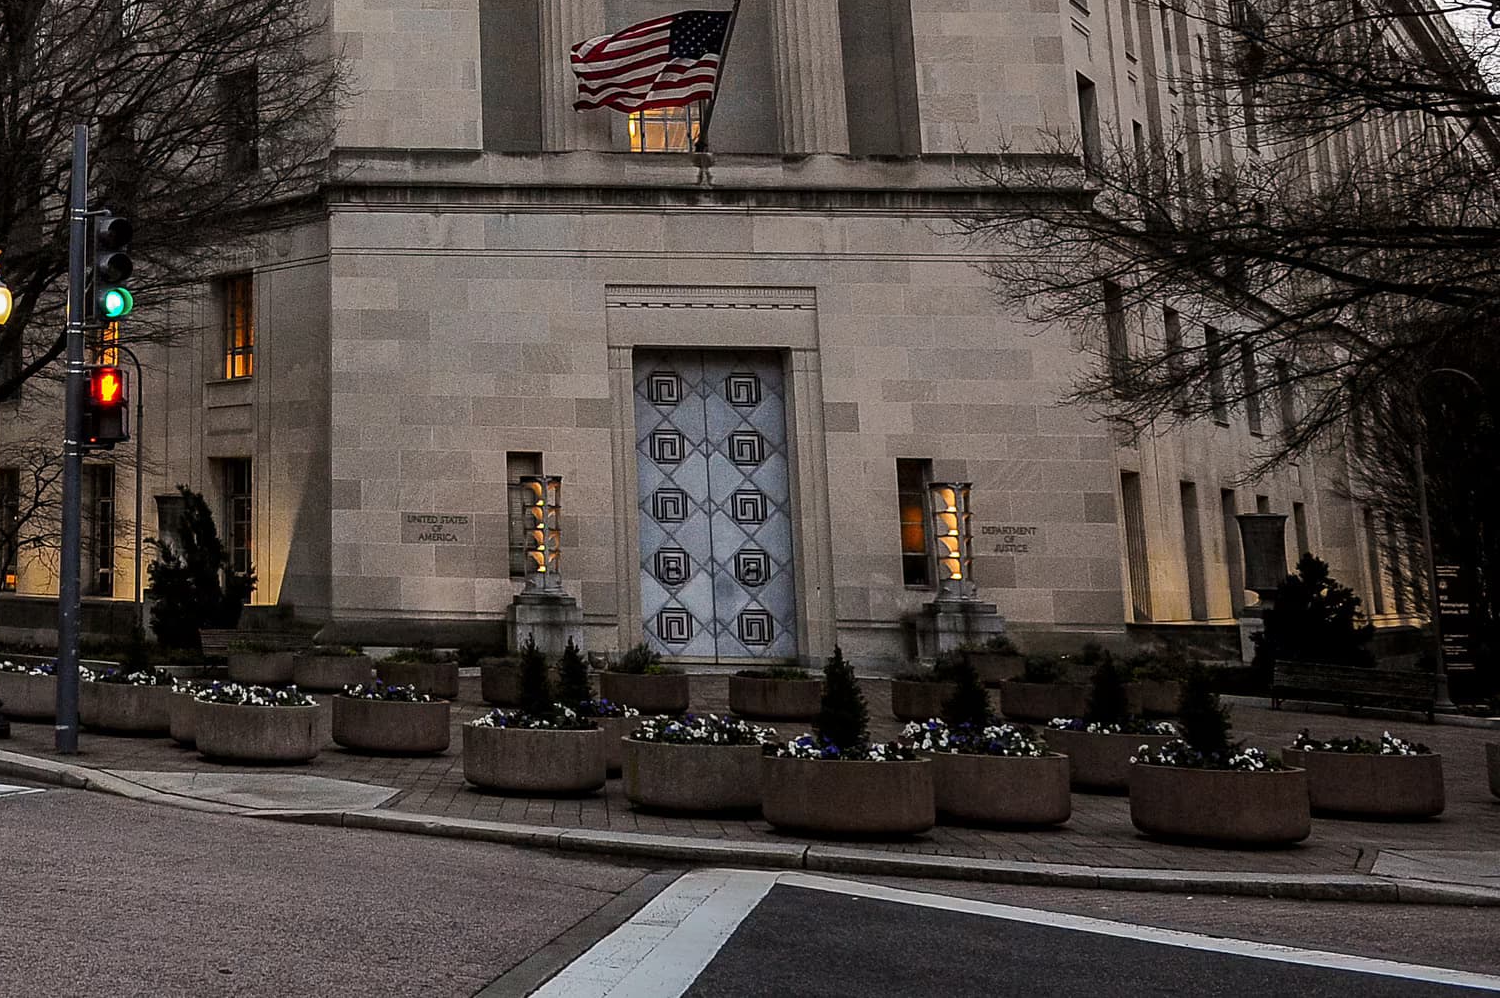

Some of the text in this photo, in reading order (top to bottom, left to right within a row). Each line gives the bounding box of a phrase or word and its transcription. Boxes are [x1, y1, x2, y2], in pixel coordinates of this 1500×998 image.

[407, 515, 468, 524] UNITED STATES
[431, 524, 444, 533] OF
[981, 526, 1037, 535] DEPARTMENT
[418, 533, 458, 542] AMERICA
[1004, 535, 1017, 543] OF
[994, 544, 1029, 553] JUSTICE
